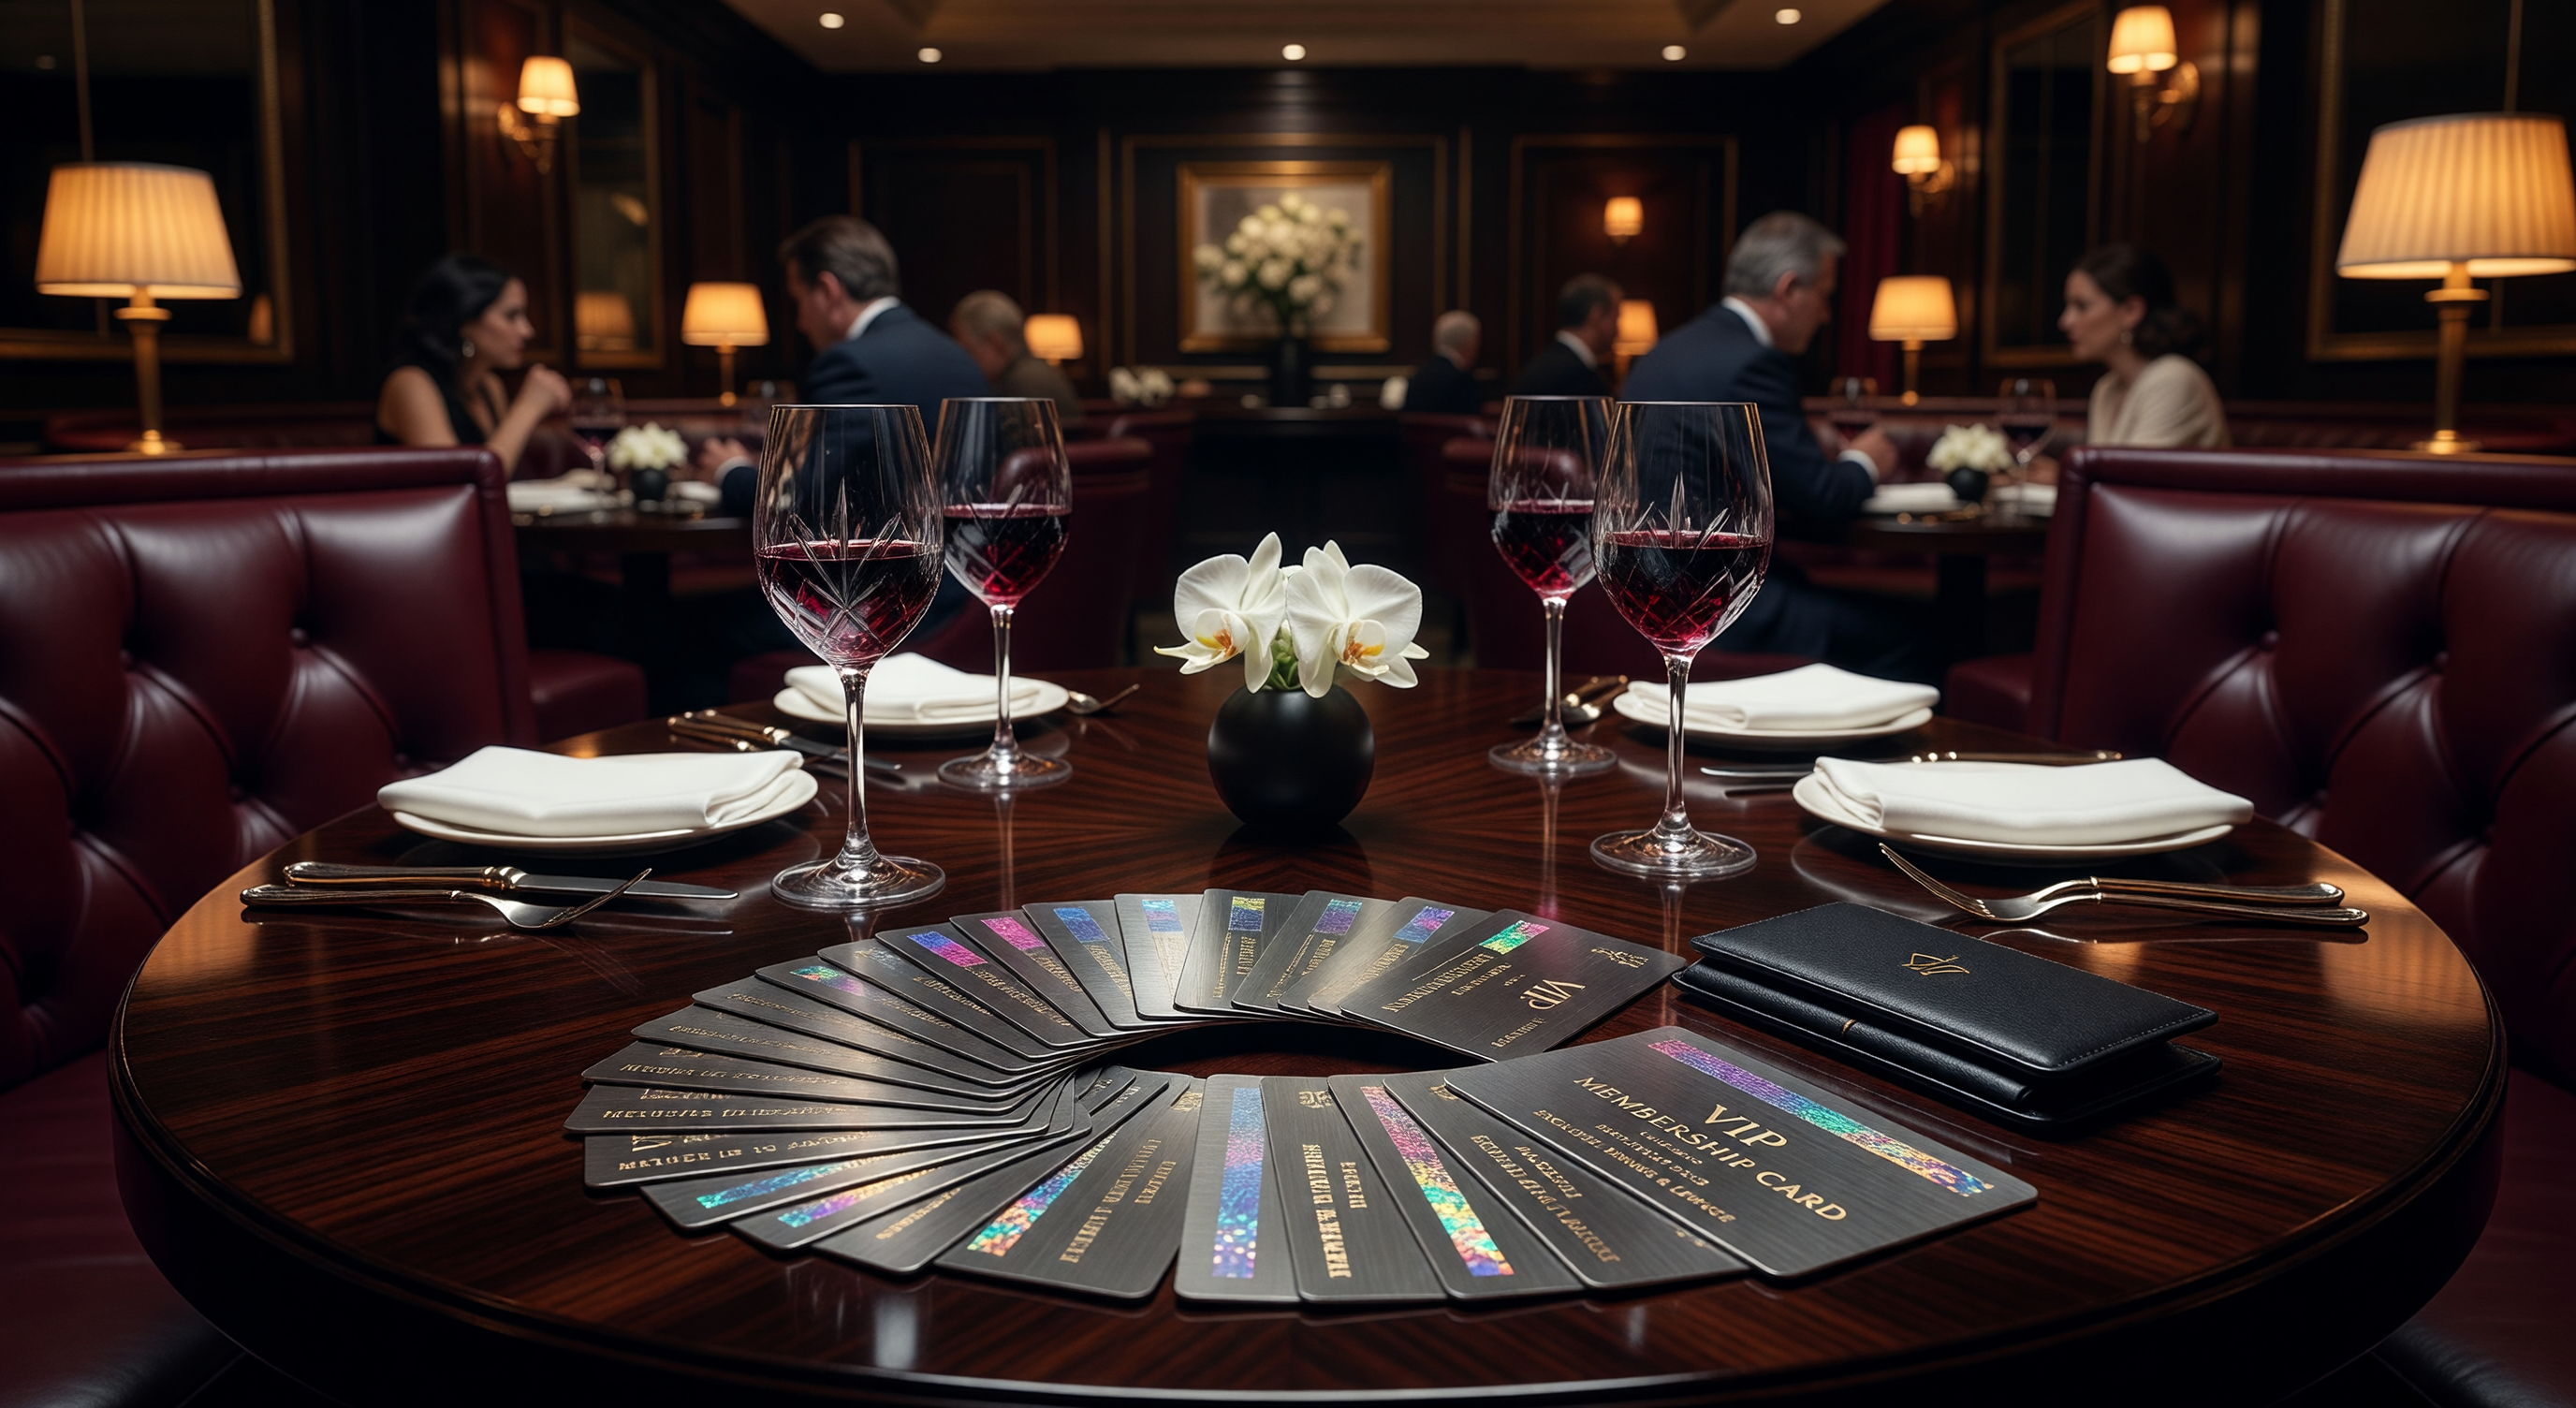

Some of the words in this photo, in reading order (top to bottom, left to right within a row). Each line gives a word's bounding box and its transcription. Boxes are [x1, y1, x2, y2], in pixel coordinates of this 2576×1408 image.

[1573, 1077, 1756, 1169] MEMBERSHIP
[1756, 1171, 1847, 1221] CARD
[1704, 1104, 1788, 1148] VIP
